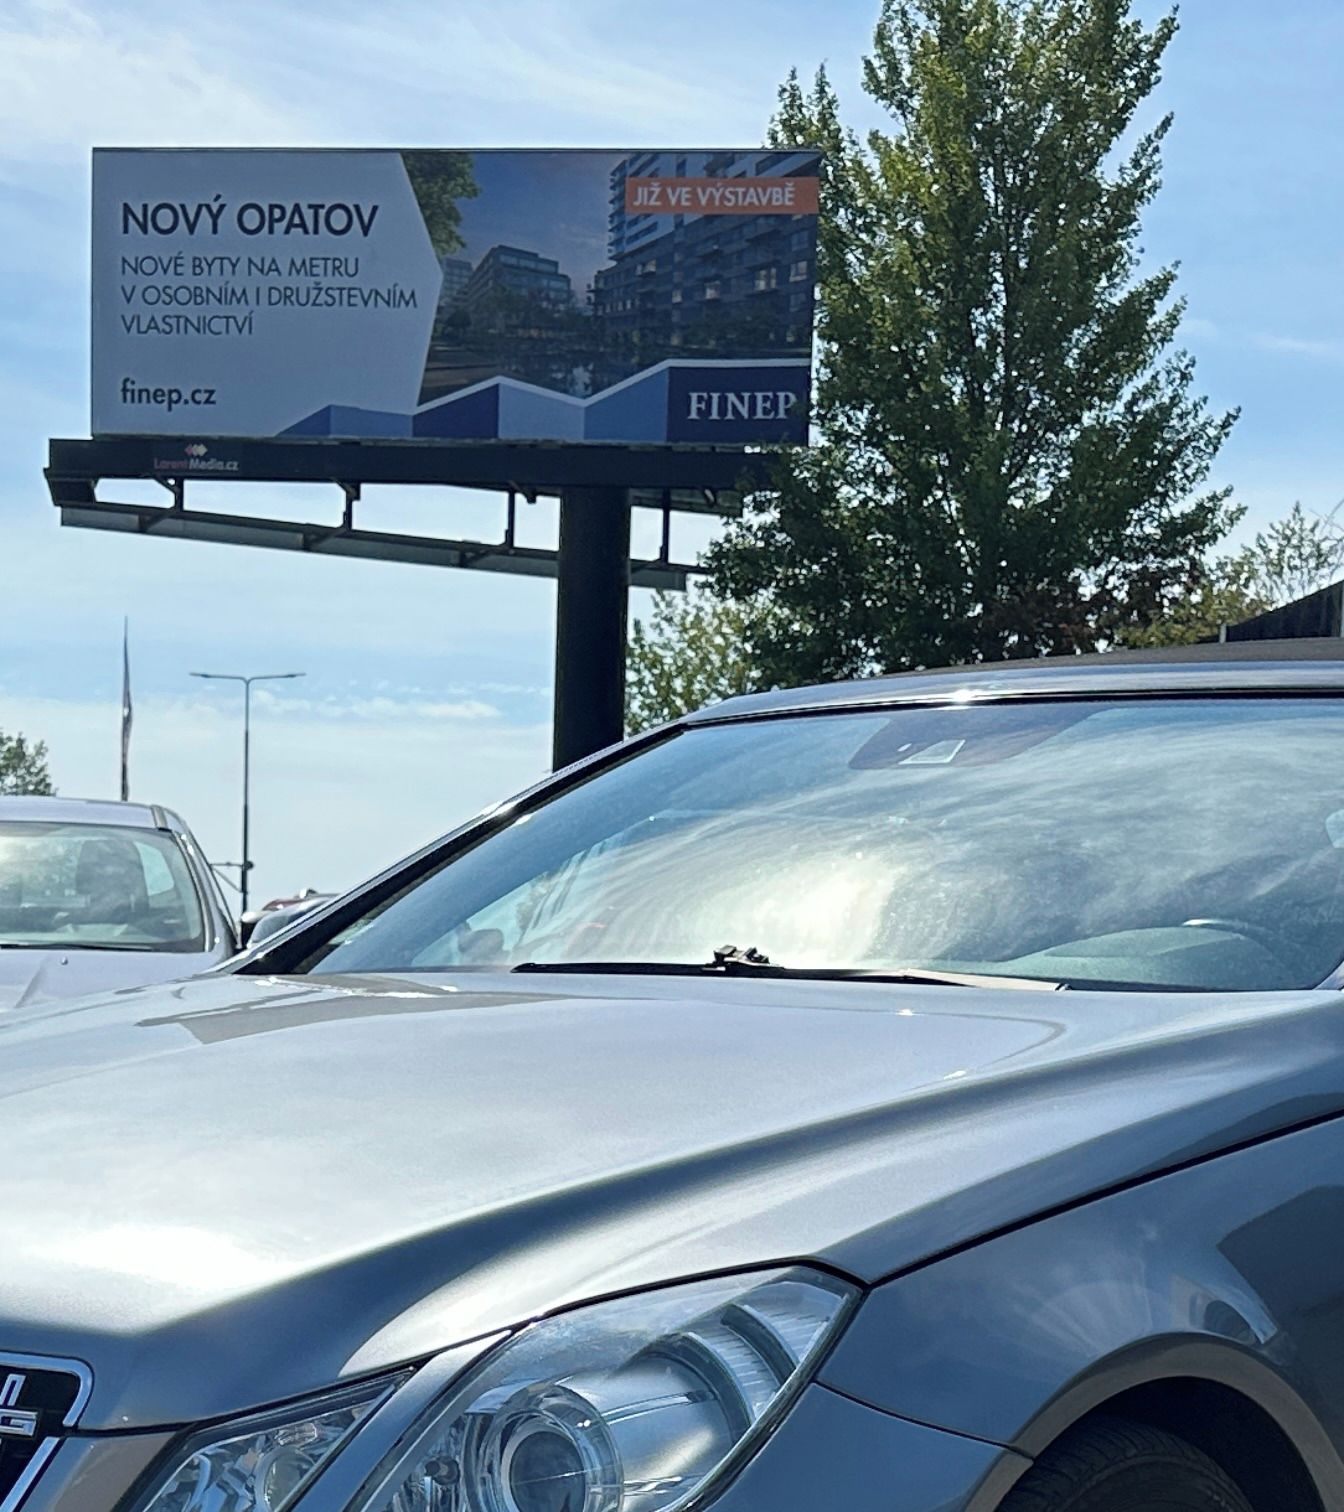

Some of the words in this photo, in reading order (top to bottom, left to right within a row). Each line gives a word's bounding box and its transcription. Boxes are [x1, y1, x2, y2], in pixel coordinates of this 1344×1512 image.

[633, 182, 661, 206] JIŽ
[666, 186, 691, 206] VE
[697, 182, 795, 206] VÝSTAVBĚ
[122, 194, 226, 235] NOVÝ
[236, 203, 379, 237] OPATOV
[121, 251, 184, 276] NOVÉ
[192, 256, 240, 277] BYTY
[247, 256, 282, 277] NA
[288, 256, 359, 278] METRU
[121, 285, 135, 305] V
[141, 281, 249, 306] OSOBNÍM
[256, 286, 260, 306] I
[267, 282, 418, 308] DRUŽSTEVNÍM
[121, 310, 254, 335] VLASTNICTVÍ
[121, 377, 217, 412] finep.cz
[687, 391, 797, 420] FINEP
